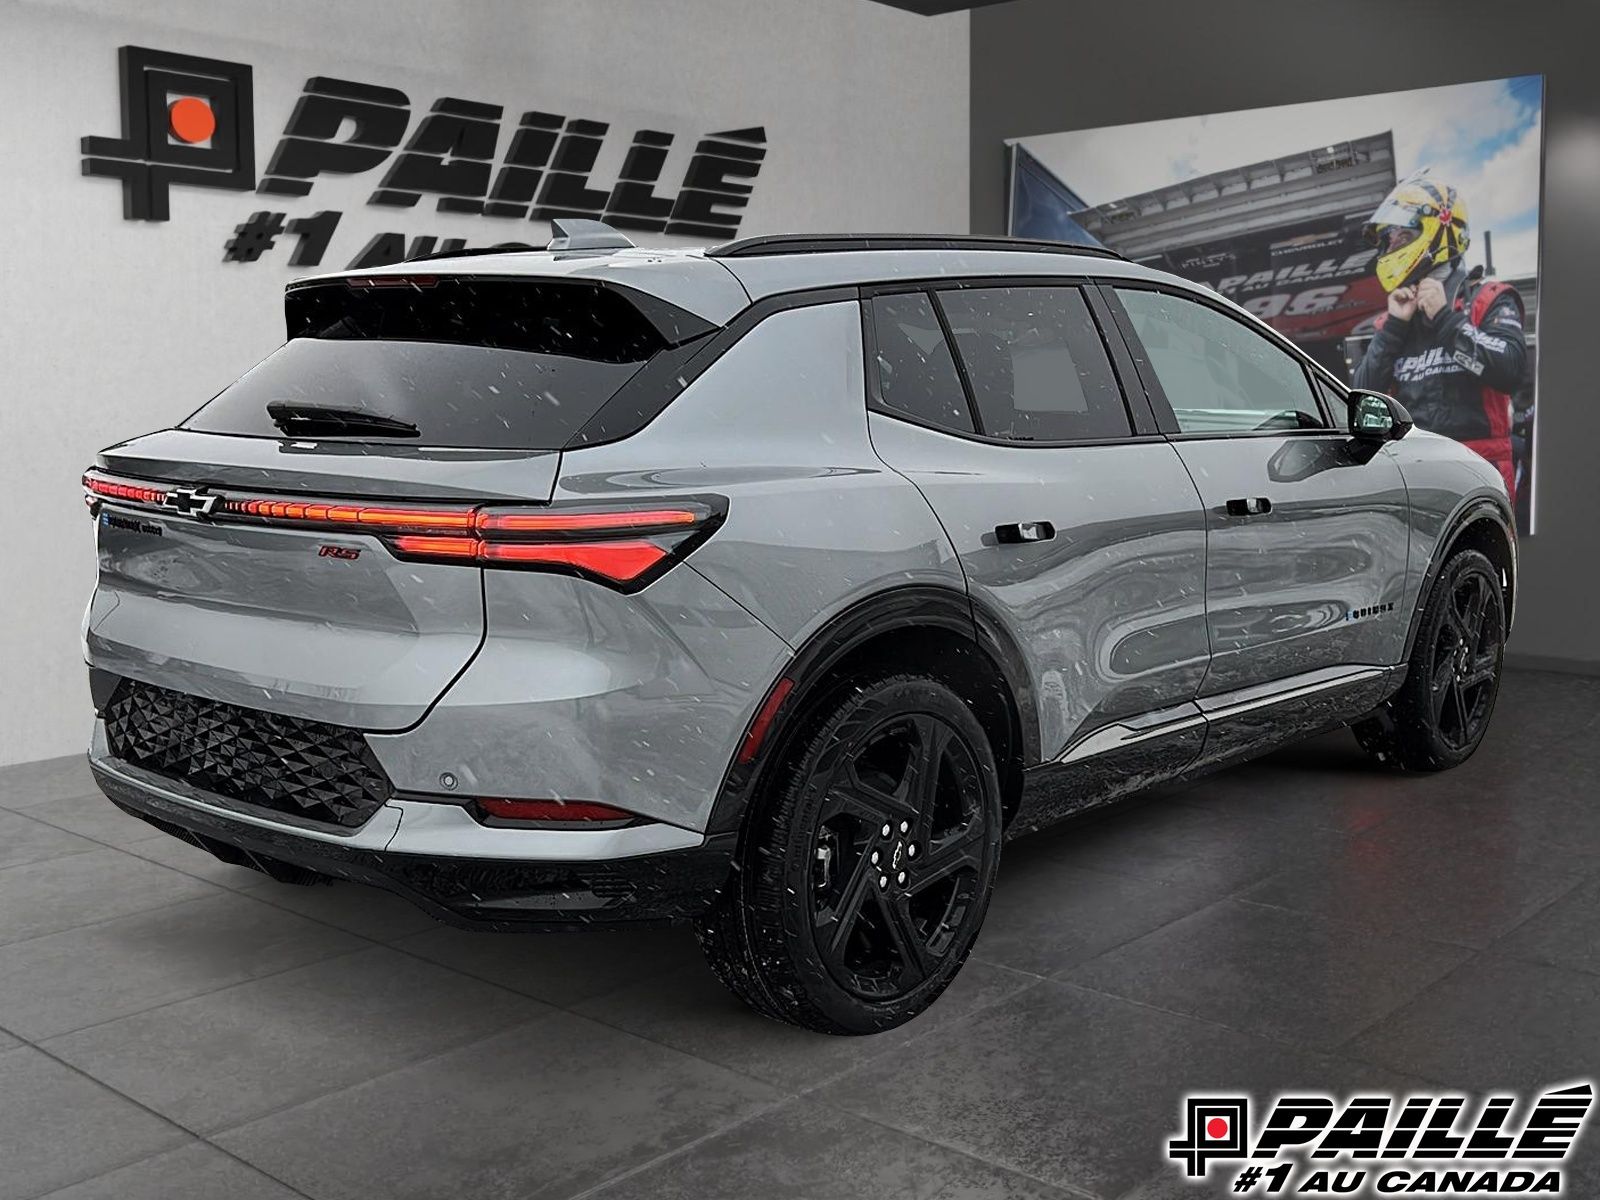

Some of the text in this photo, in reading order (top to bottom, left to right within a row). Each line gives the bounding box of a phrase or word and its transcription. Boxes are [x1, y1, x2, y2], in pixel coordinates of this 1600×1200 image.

[255, 75, 767, 239] PAILLÉ
[222, 209, 344, 268] #1
[1243, 284, 1349, 319] 96
[318, 545, 362, 560] RS
